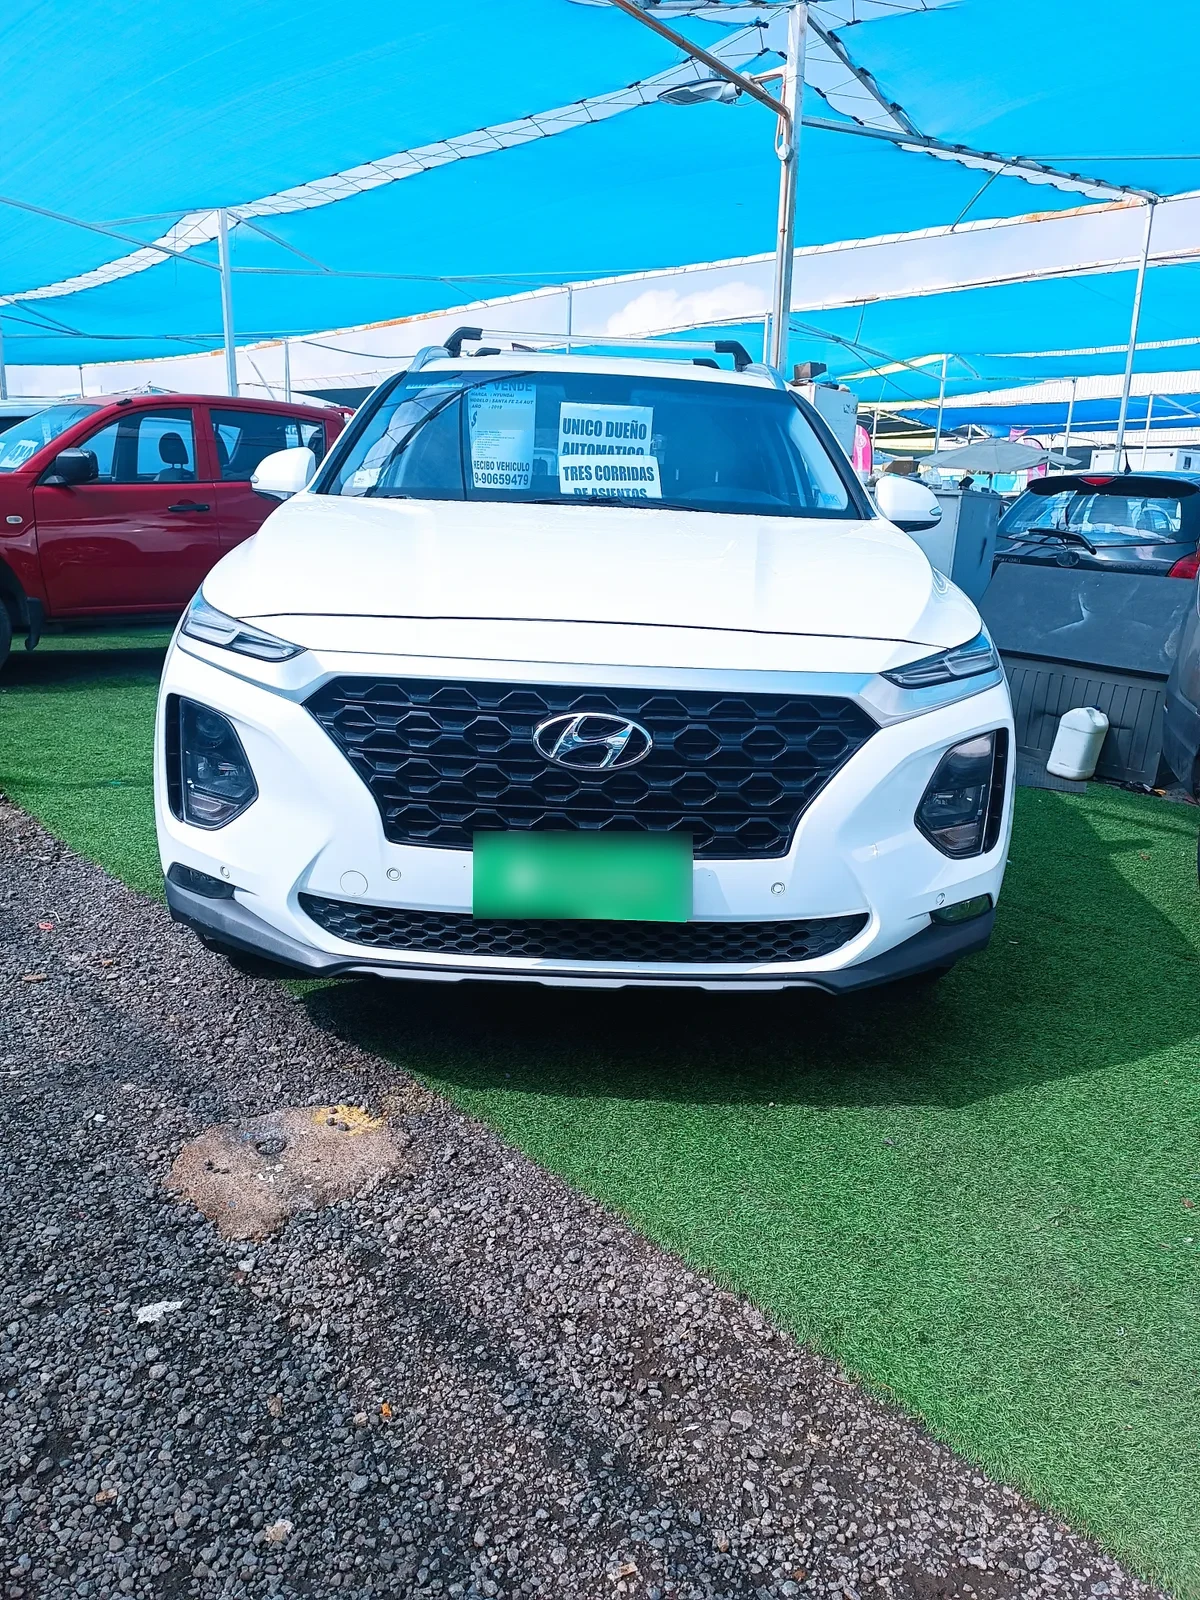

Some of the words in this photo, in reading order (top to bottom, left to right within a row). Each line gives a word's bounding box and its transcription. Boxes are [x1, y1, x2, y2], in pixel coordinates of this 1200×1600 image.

[493, 381, 532, 392] VENDE
[562, 417, 603, 437] UNICO
[605, 420, 647, 440] DUEÑO
[561, 441, 645, 456] AUTOMATICO
[473, 460, 495, 470] RECIBO
[497, 461, 530, 472] VEHICULO
[562, 465, 593, 481] TRES
[594, 465, 655, 482] CORRIDAS
